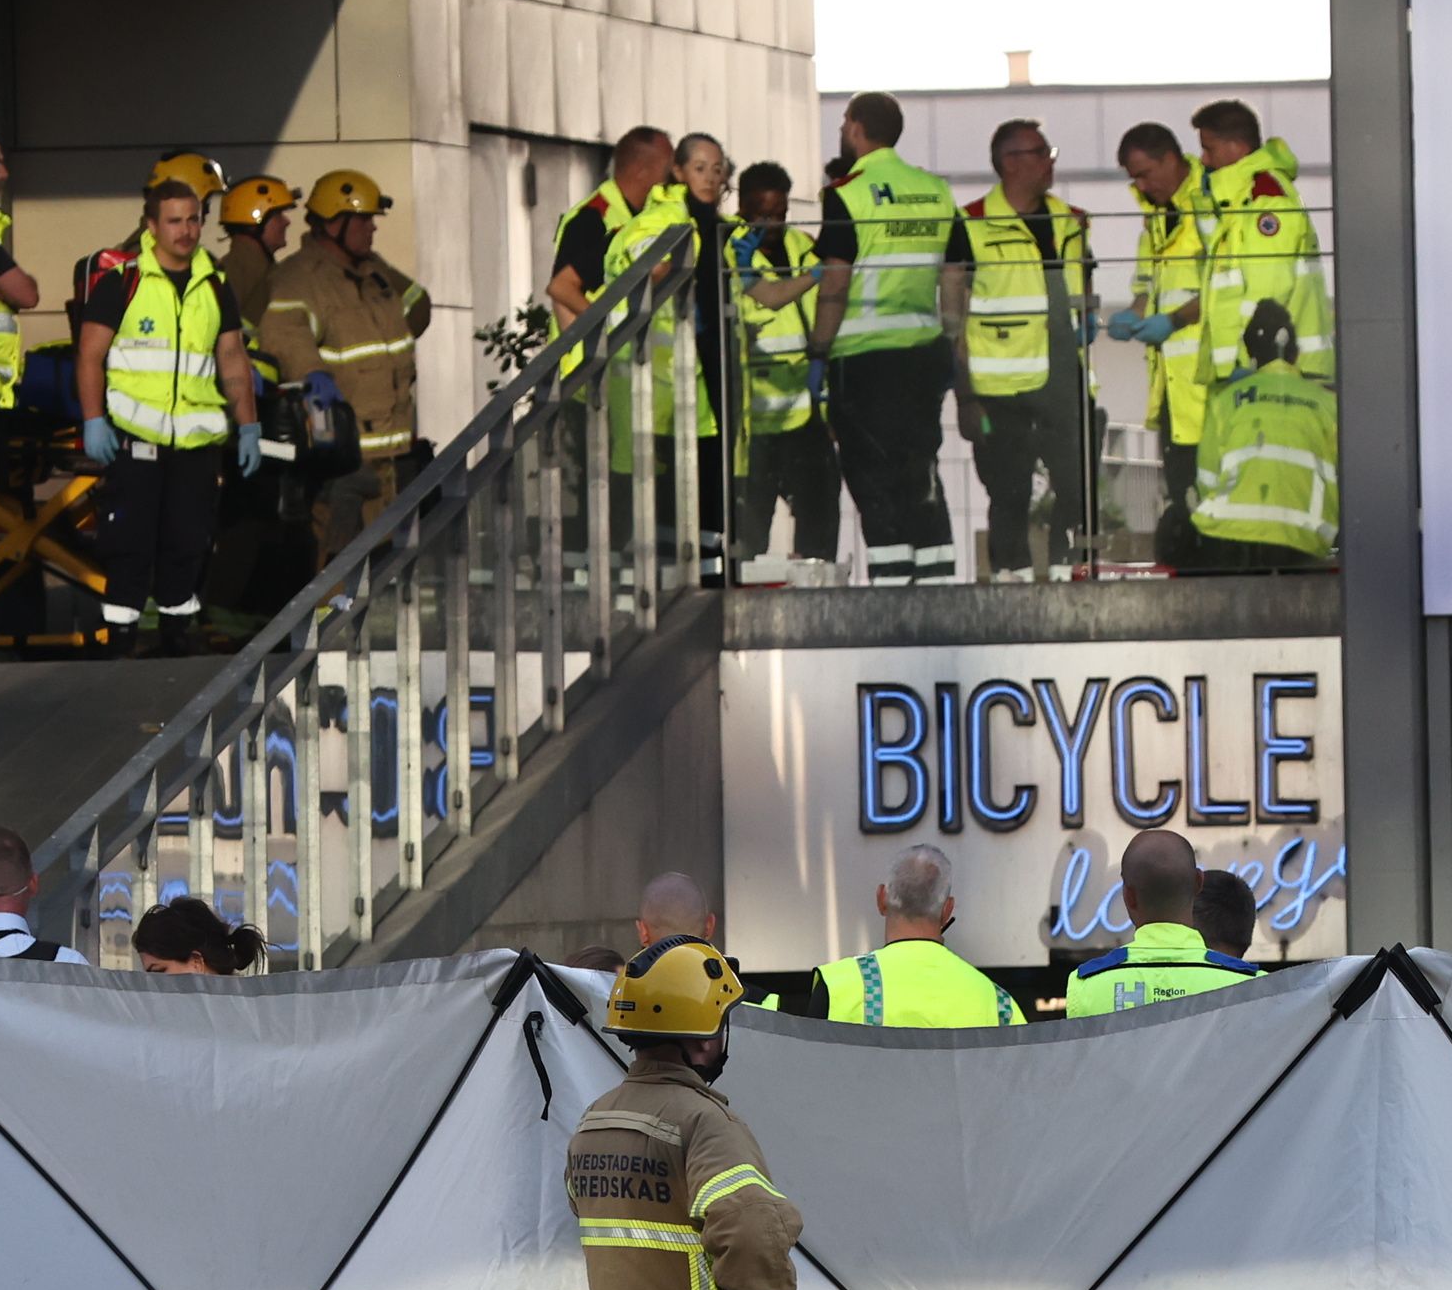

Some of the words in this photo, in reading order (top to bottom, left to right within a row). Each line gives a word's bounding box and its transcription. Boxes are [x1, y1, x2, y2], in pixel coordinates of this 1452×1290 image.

[856, 672, 1320, 834] BICYCLE
[1153, 987, 1186, 996] Region
[571, 1153, 669, 1178] VEDSTADENS
[573, 1175, 671, 1204] REDSKAB
